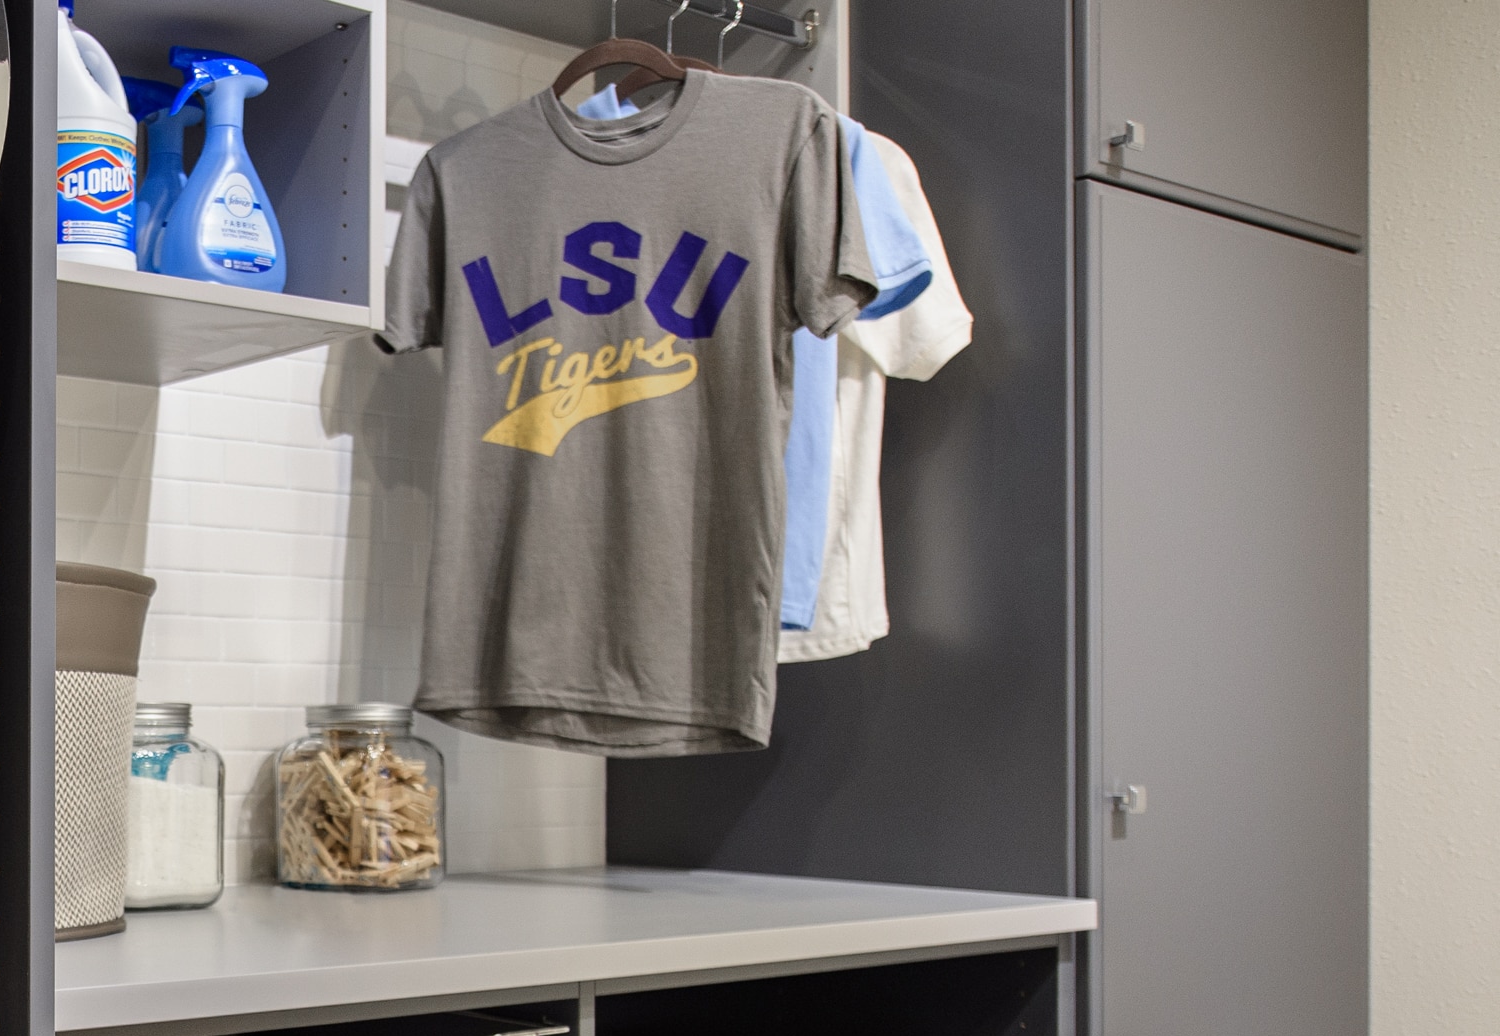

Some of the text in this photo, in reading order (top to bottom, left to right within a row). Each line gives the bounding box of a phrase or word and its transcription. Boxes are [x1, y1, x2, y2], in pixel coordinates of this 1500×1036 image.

[63, 166, 131, 200] CLOROX
[224, 219, 257, 231] FABRIC
[462, 221, 750, 347] LSU
[496, 333, 690, 419] Tigers
